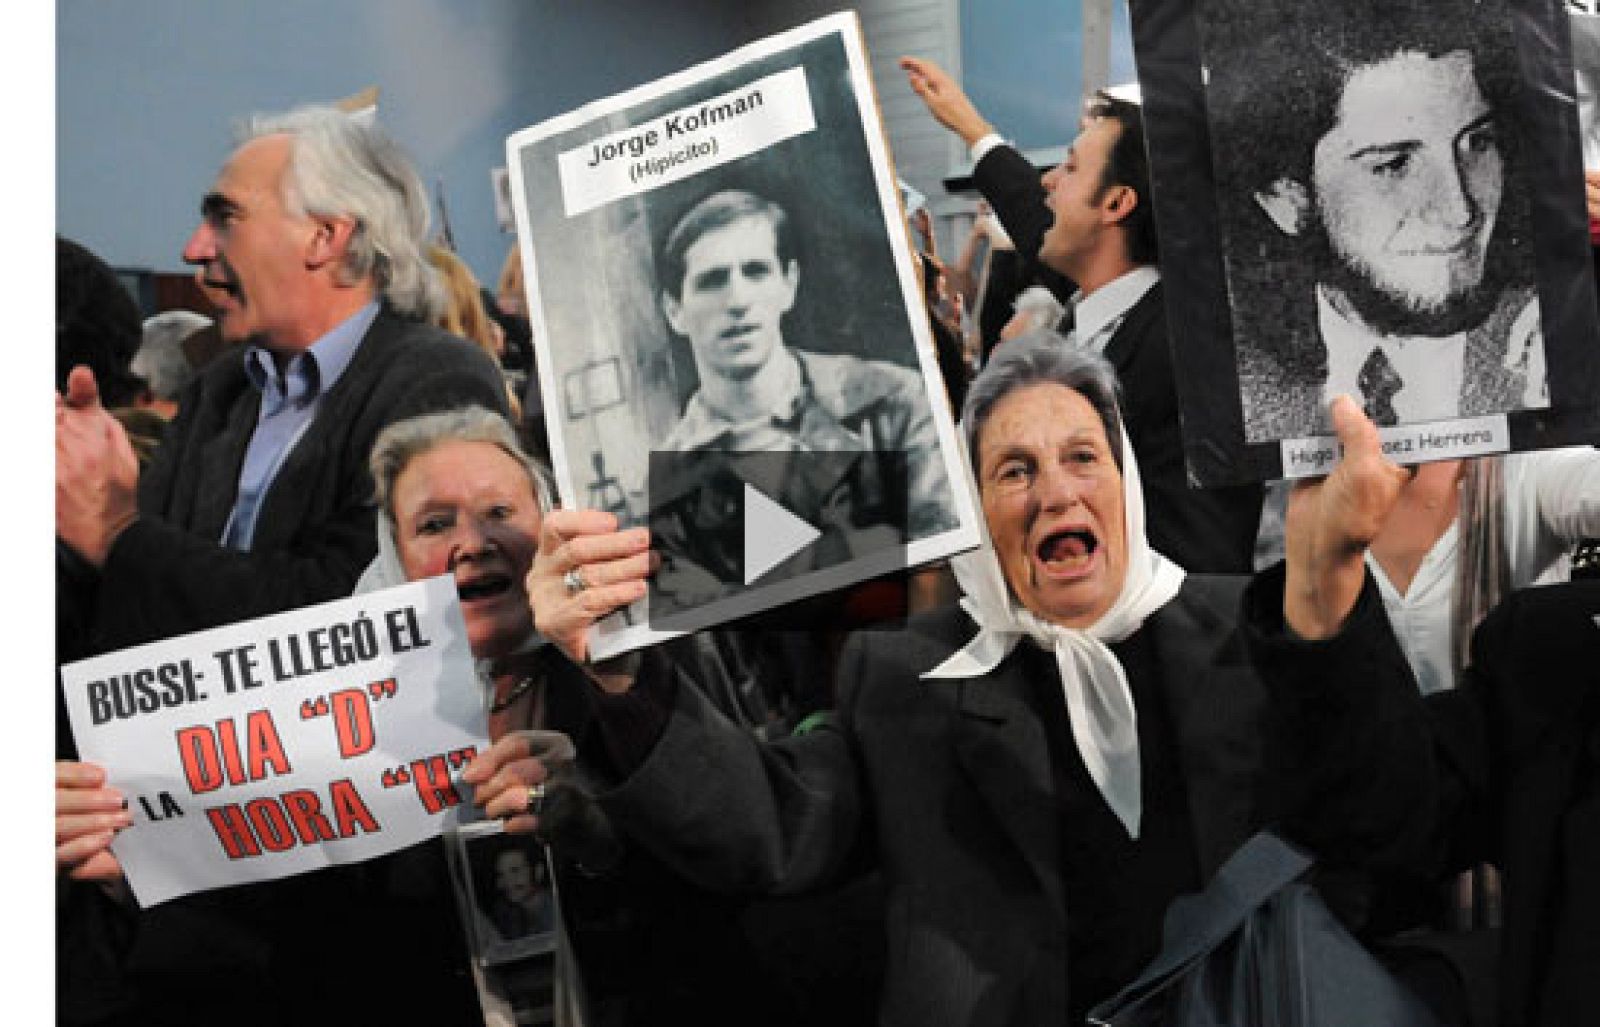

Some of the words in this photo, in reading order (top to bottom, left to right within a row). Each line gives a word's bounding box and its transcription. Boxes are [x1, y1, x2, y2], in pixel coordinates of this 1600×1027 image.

[587, 130, 658, 167] Jorge
[629, 137, 719, 183] (Hipicito)
[1290, 446, 1334, 468] Hugo
[1418, 430, 1494, 450] Herrera
[87, 660, 208, 727] BUSSI:
[212, 643, 264, 694] TE
[267, 610, 379, 682] LLEGÓ
[383, 605, 432, 655] EL
[175, 709, 293, 795] DIA
[137, 791, 185, 821] LA
[204, 777, 382, 861] HORA
